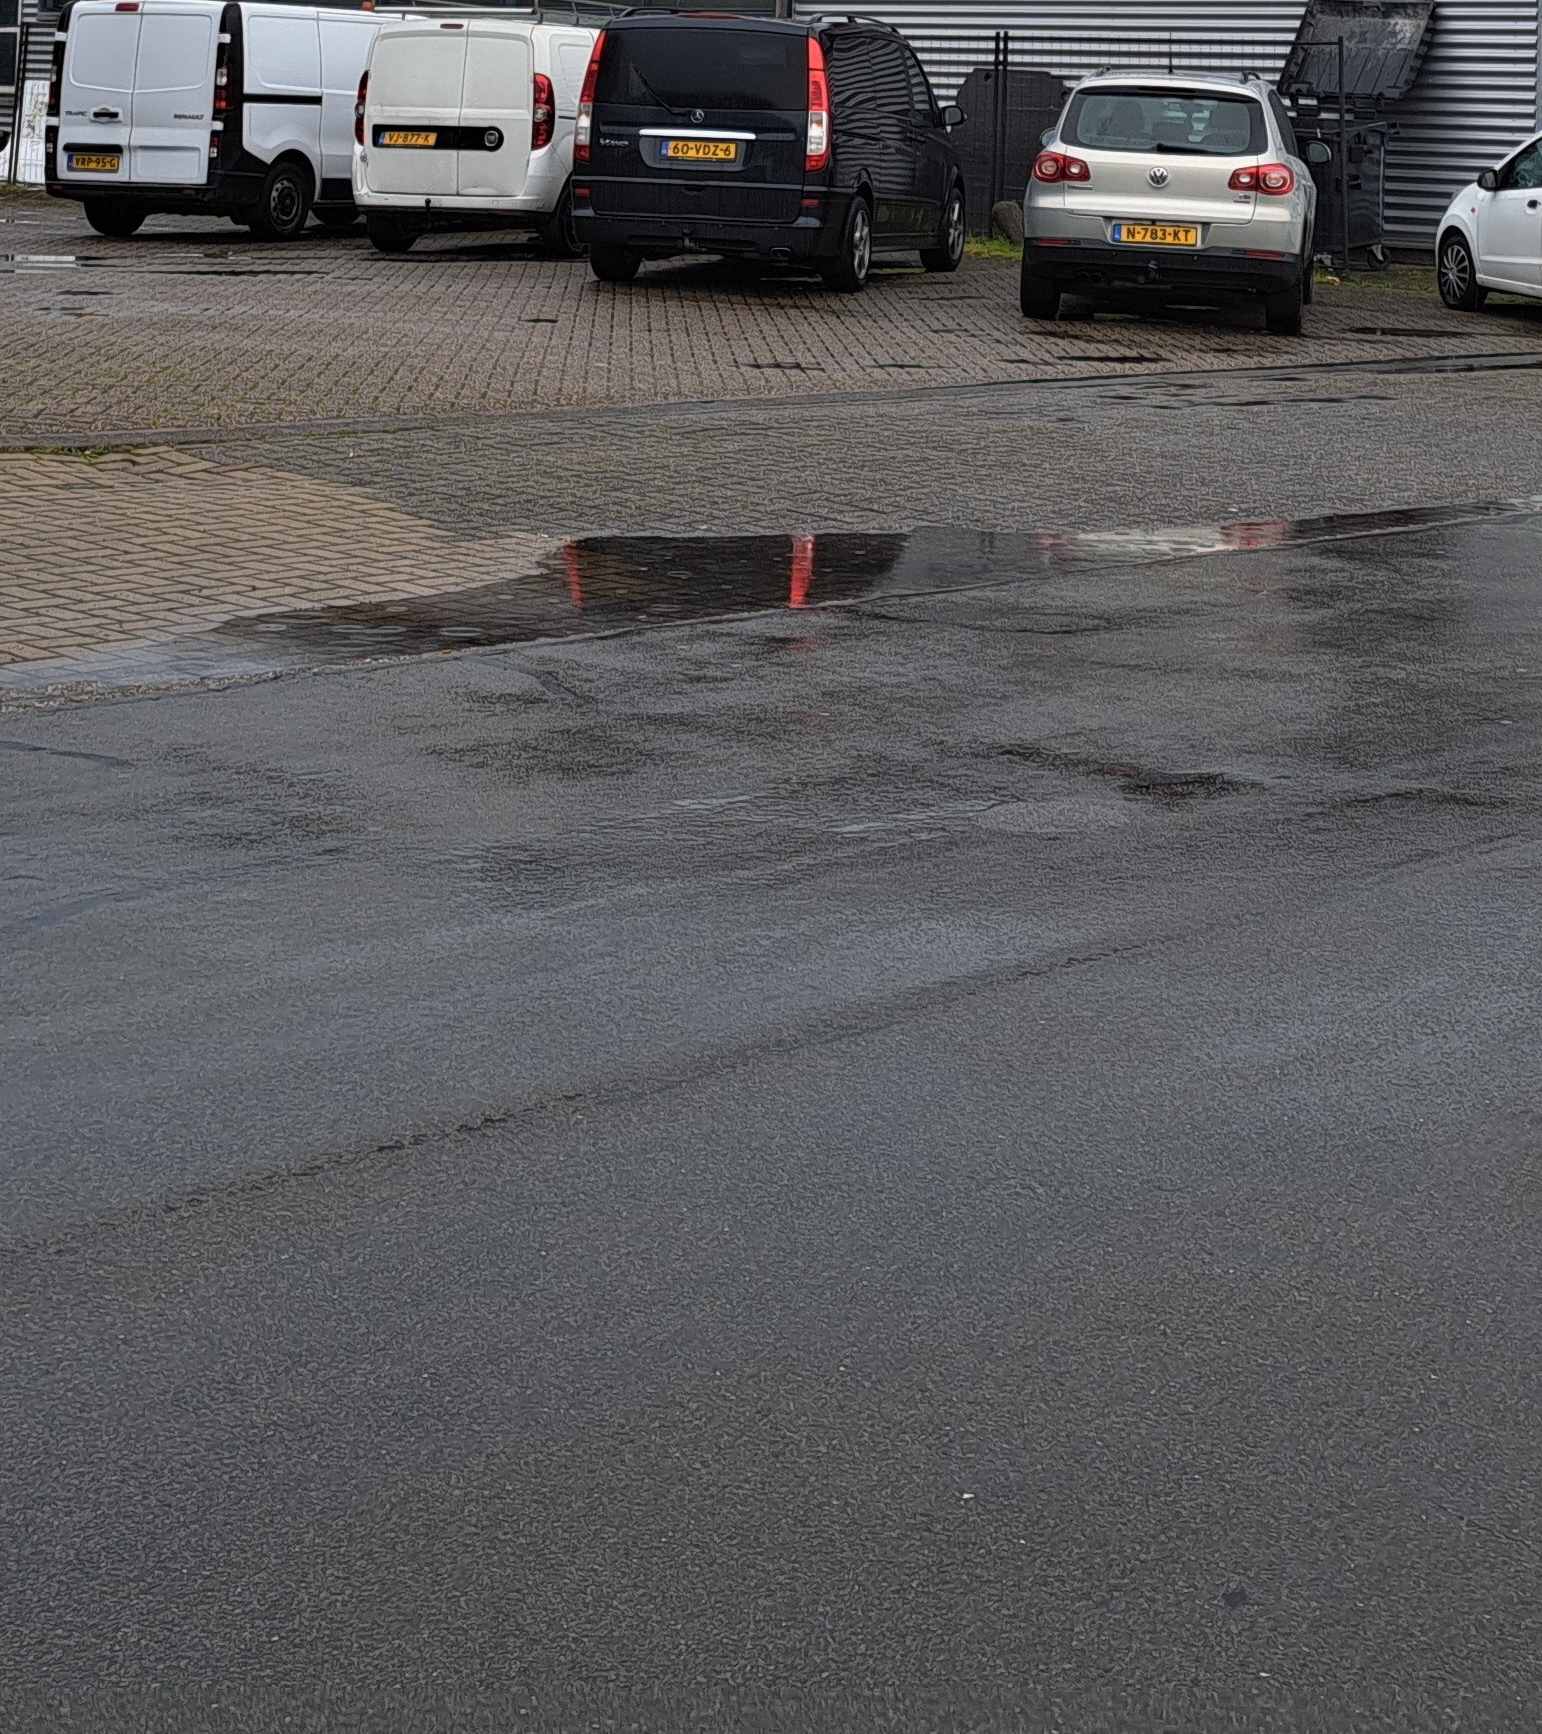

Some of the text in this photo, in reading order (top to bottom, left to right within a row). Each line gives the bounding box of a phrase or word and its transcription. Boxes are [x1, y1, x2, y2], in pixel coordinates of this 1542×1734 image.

[388, 132, 431, 144] VJ-877-K
[672, 142, 732, 157] 60-VDZ-6
[75, 156, 116, 168] VRP-95-G
[1126, 227, 1192, 243] N-783-KT
